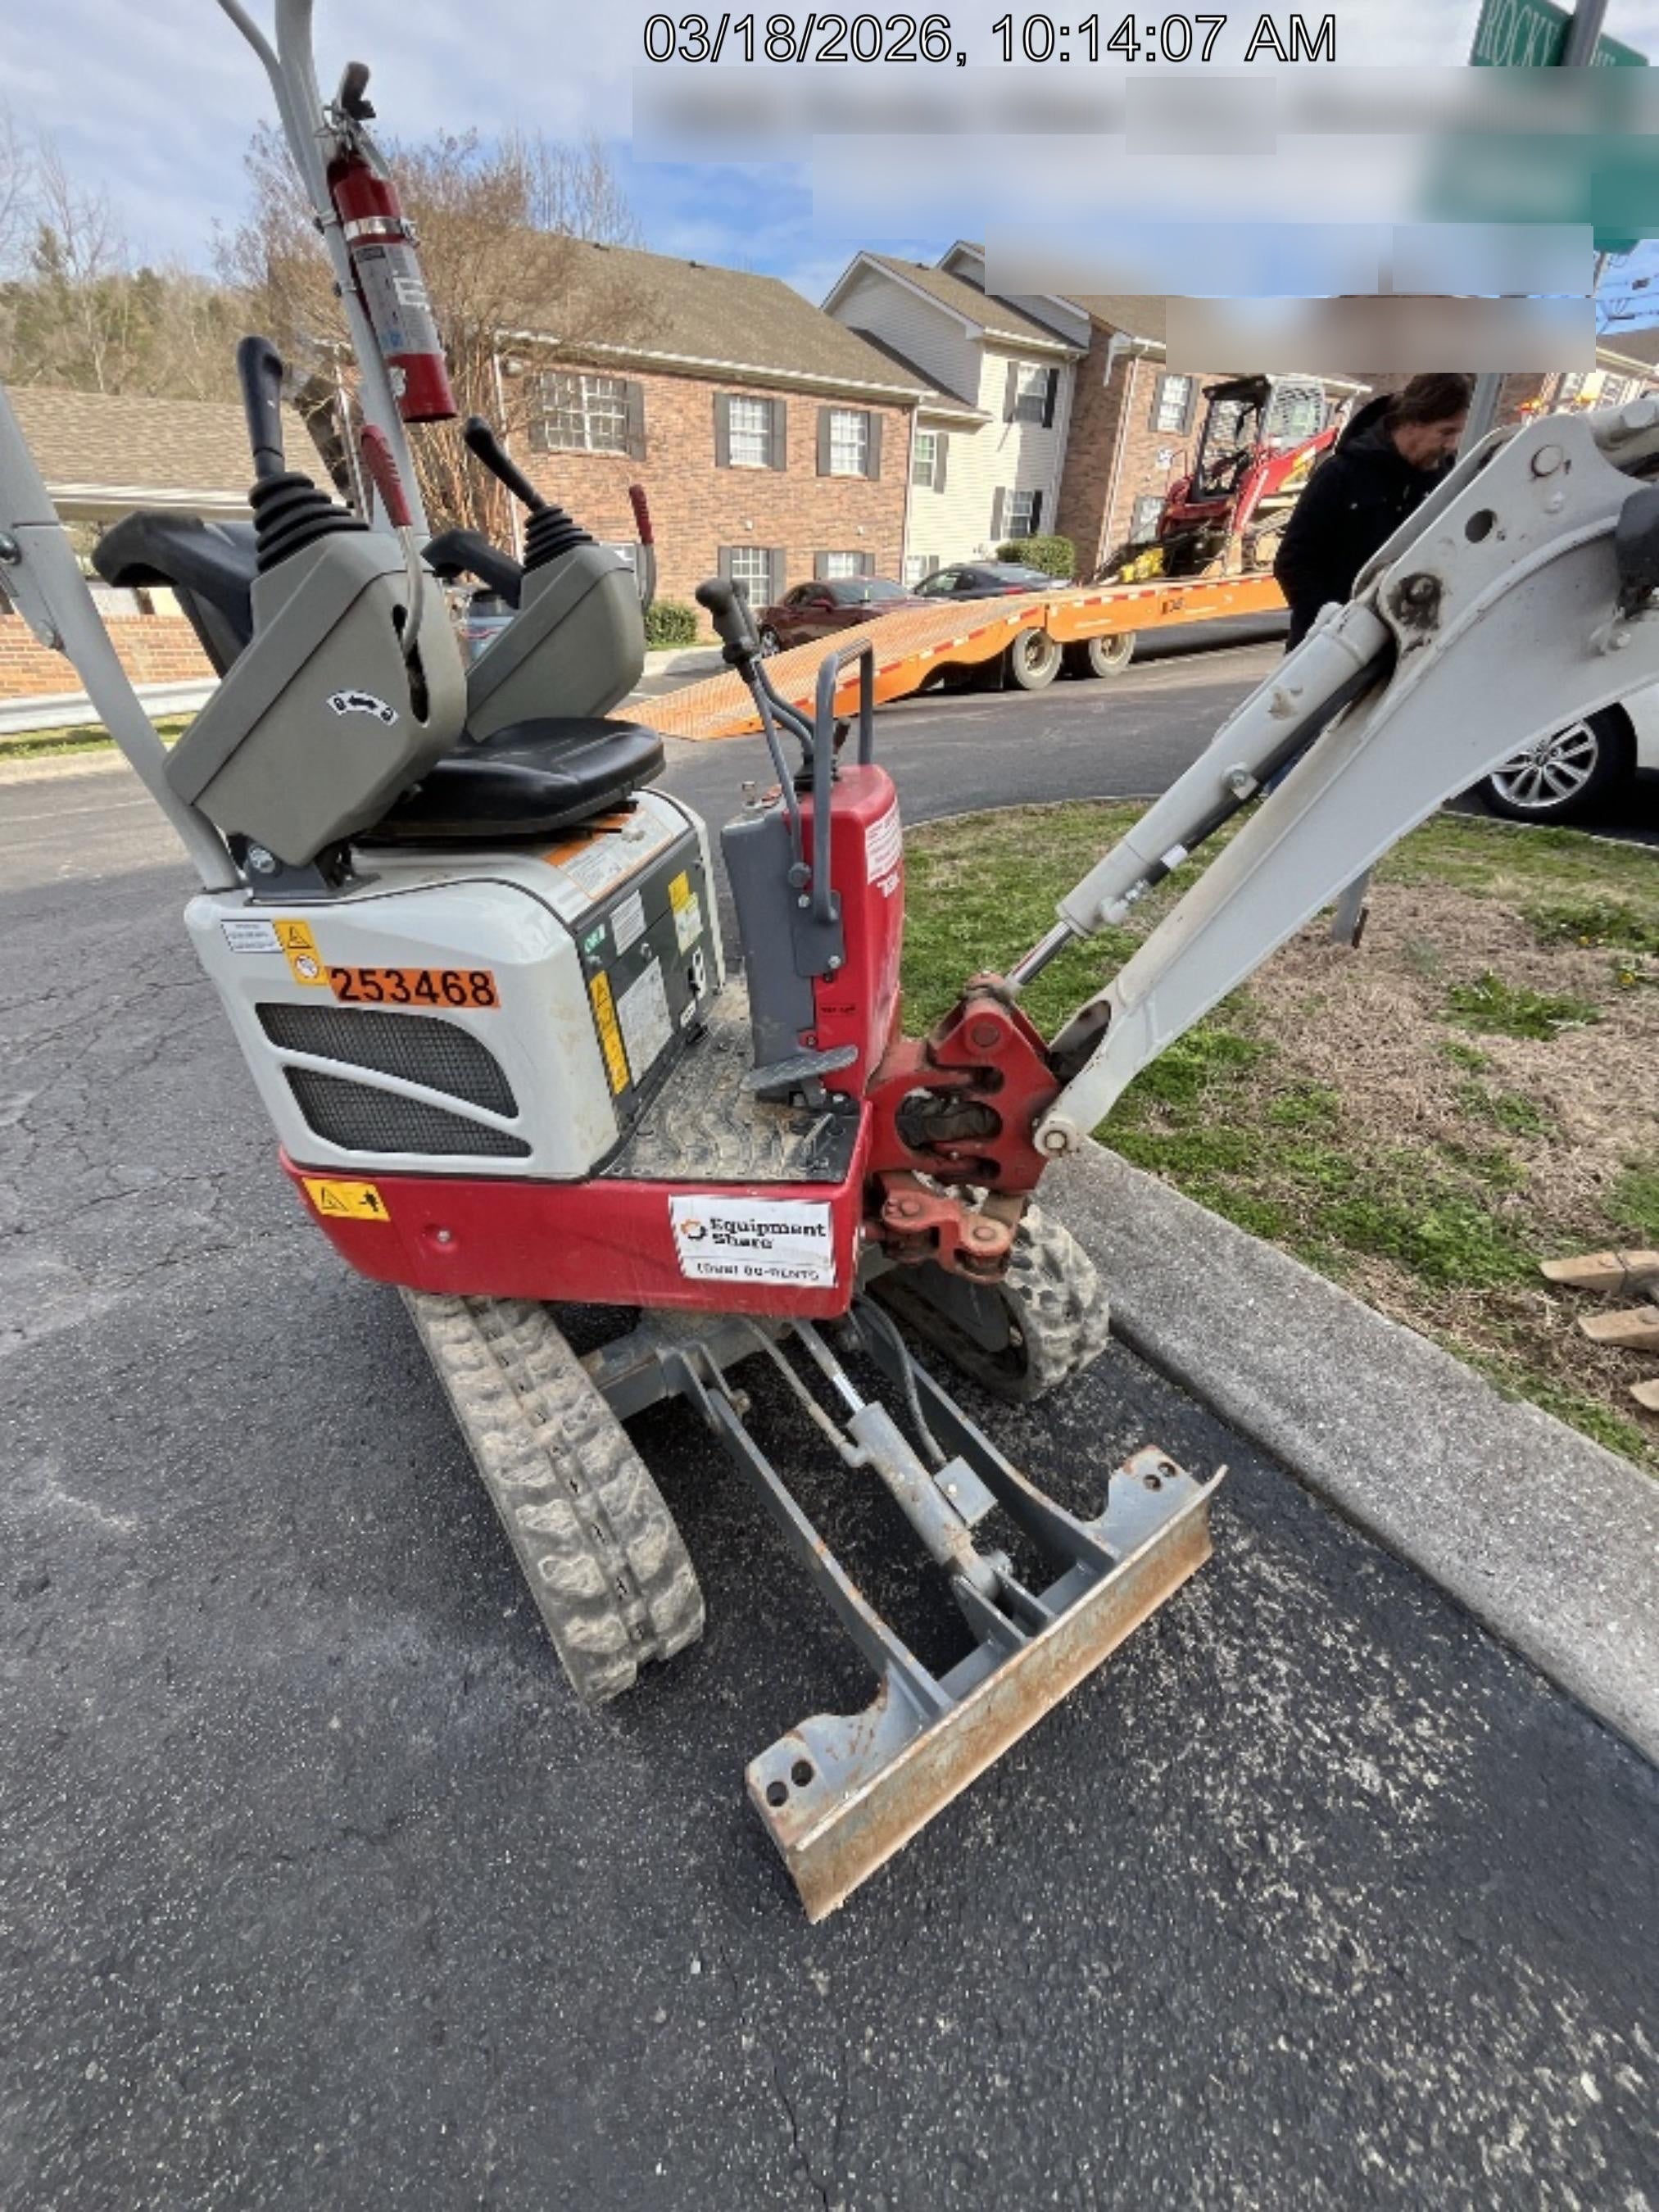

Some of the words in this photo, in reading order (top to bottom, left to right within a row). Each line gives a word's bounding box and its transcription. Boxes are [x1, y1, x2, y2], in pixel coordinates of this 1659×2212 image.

[331, 968, 495, 1006] 253468
[709, 1218, 827, 1238] Equipment
[712, 1233, 773, 1249] Share
